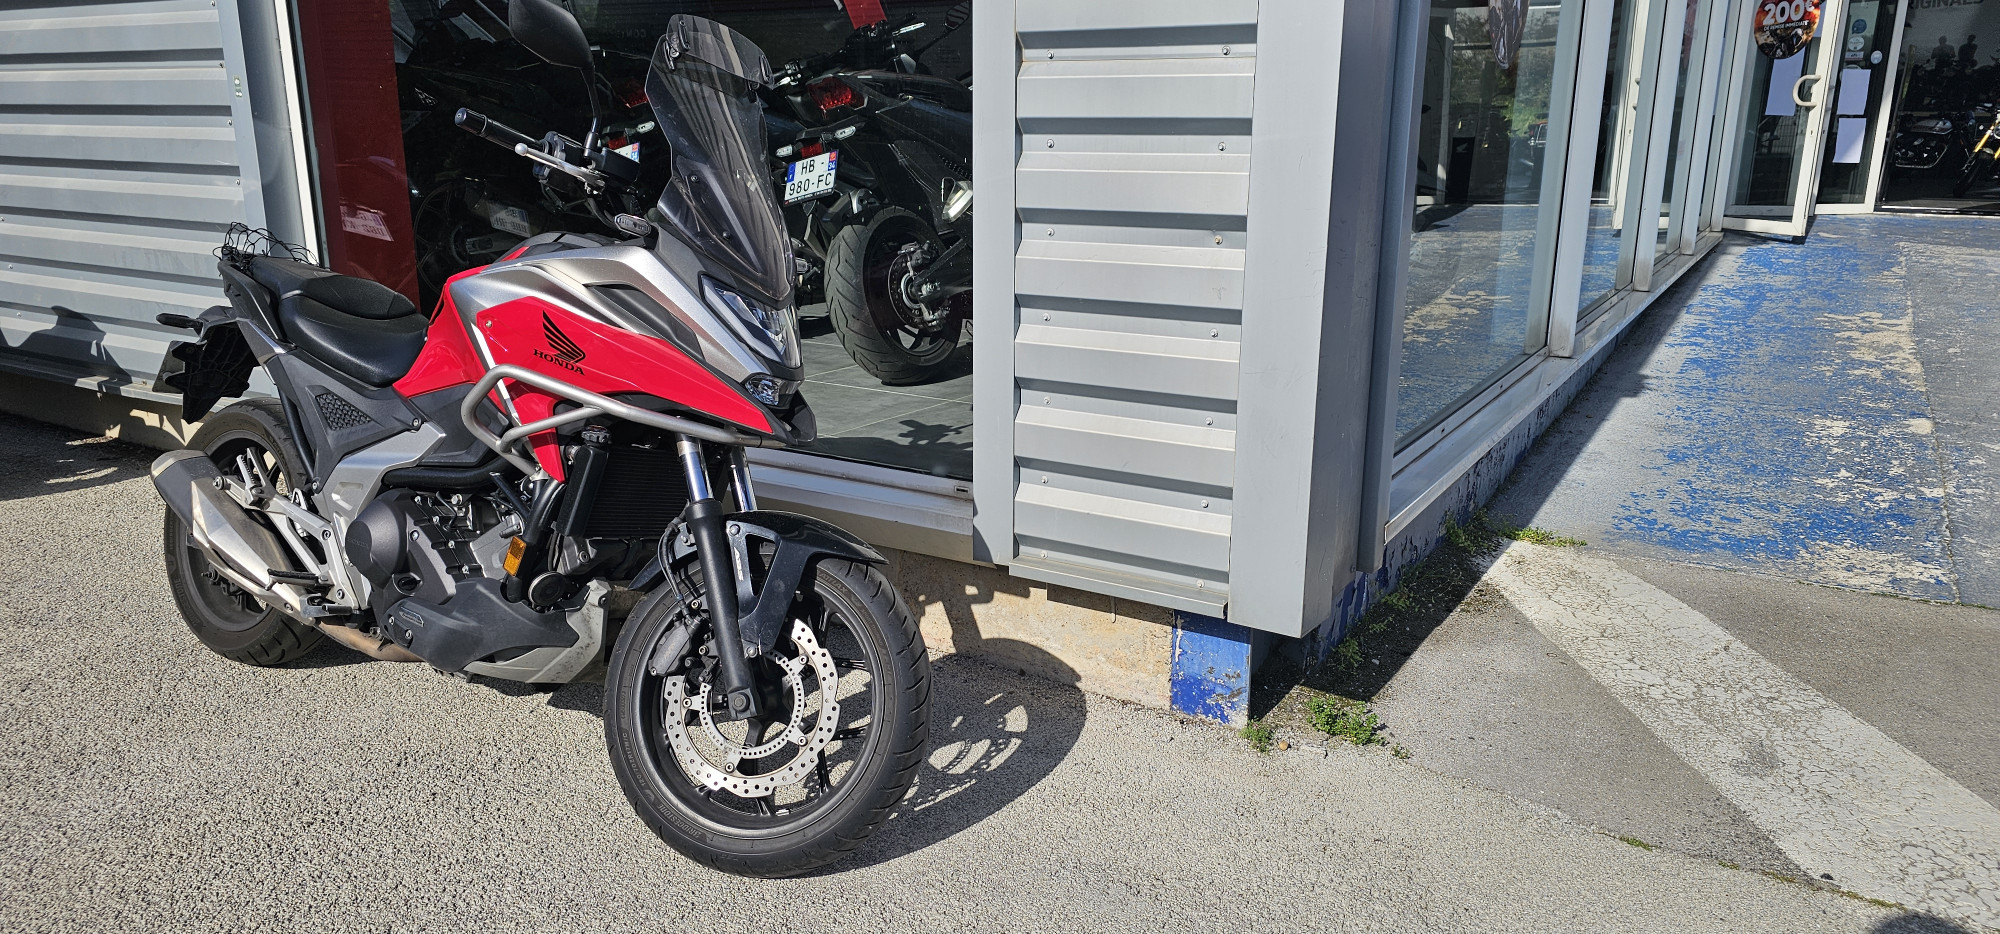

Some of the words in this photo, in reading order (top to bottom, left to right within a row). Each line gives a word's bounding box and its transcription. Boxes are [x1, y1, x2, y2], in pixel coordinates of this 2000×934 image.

[801, 159, 815, 175] HB
[789, 172, 832, 196] 980-FC
[533, 348, 586, 377] HONDA
[818, 571, 848, 593] ATTLAX
